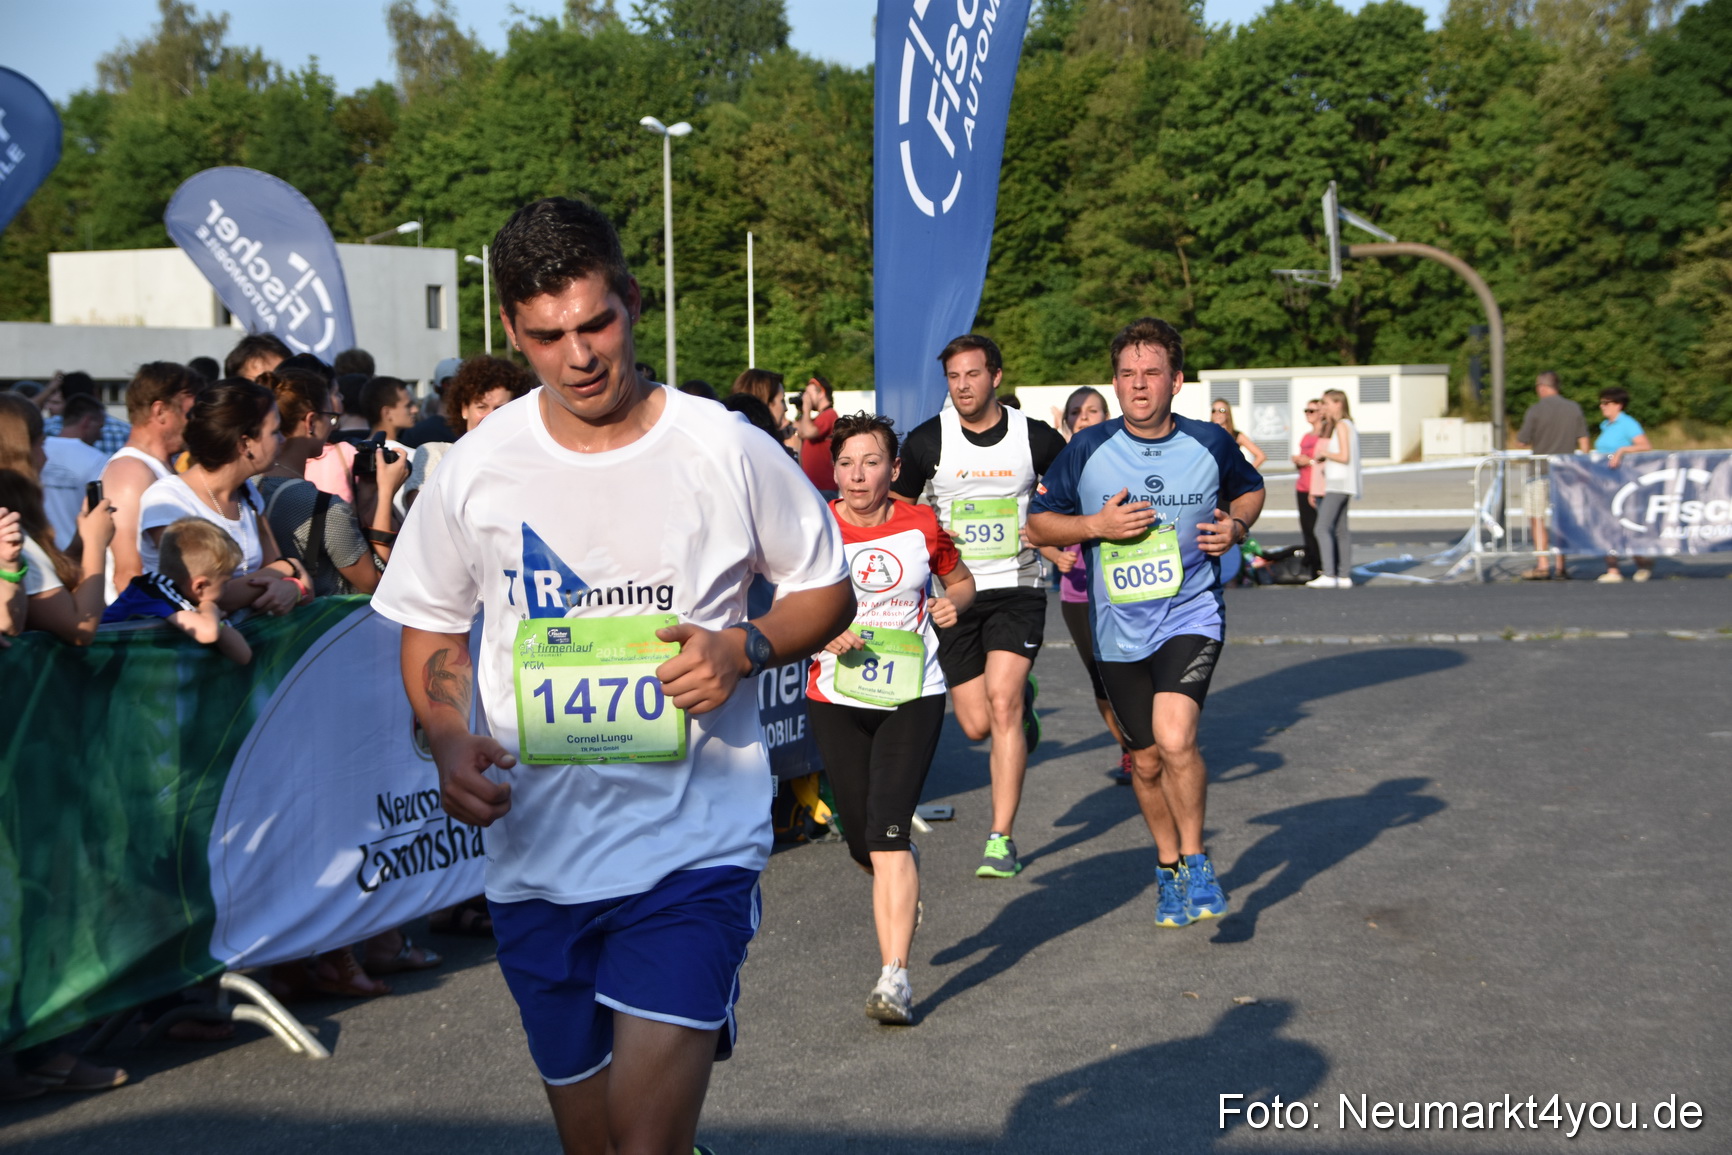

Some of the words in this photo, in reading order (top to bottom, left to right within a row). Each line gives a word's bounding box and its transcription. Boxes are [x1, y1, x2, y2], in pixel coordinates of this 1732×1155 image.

[1645, 494, 1732, 523] Fisc
[965, 523, 1005, 543] 593
[1113, 559, 1173, 590] 6085
[537, 641, 594, 653] firmenlauf
[595, 647, 626, 658] 2015
[862, 657, 895, 685] 81
[533, 675, 665, 724] 1470
[567, 734, 599, 744] Cornel
[601, 733, 633, 744] Lungu
